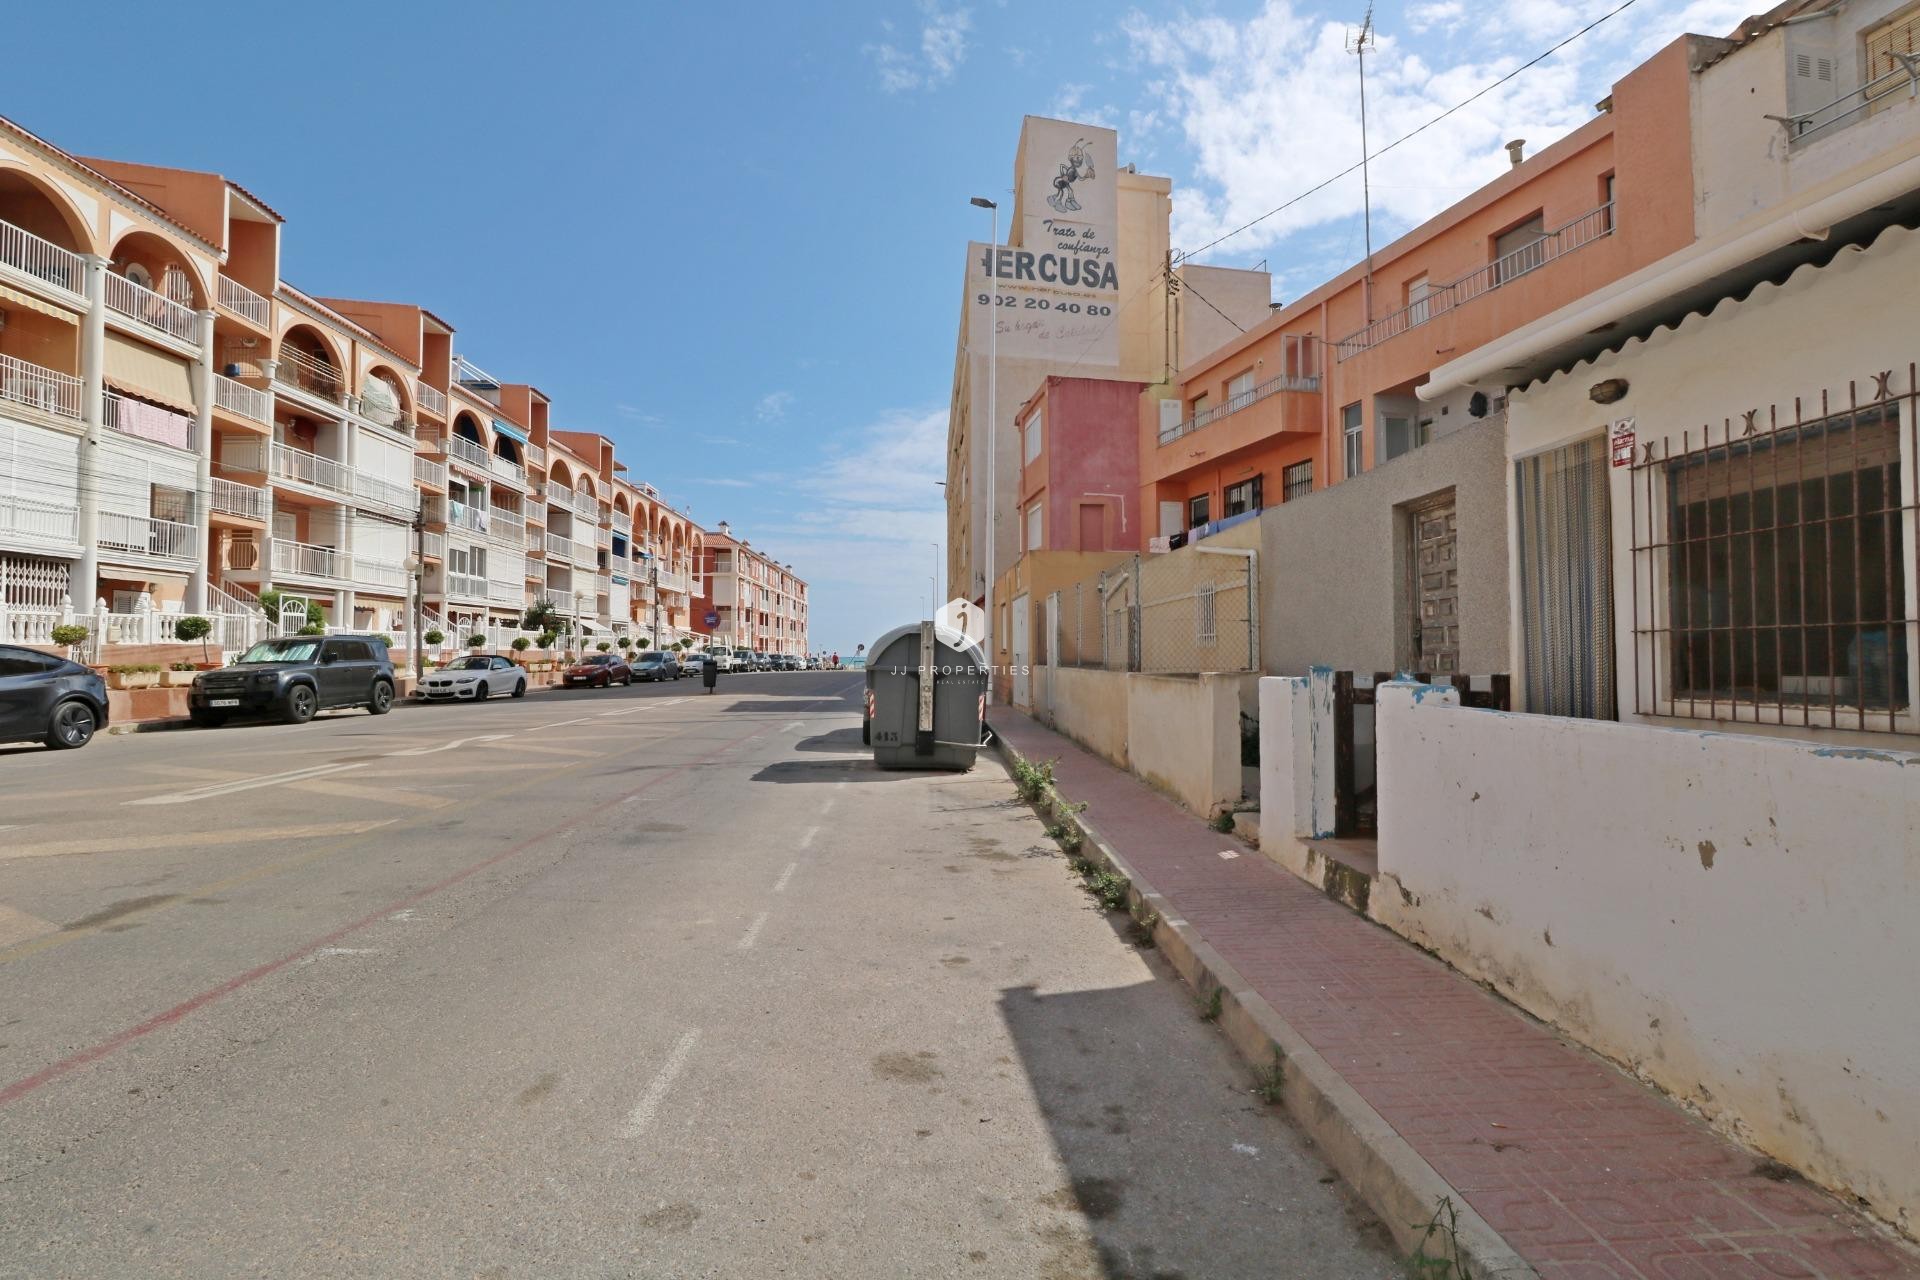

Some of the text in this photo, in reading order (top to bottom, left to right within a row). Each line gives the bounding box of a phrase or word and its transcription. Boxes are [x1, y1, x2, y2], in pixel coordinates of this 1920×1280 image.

[1042, 219, 1096, 240] Trato de
[1057, 239, 1111, 260] confianza
[977, 293, 1111, 317] 902 20 40 80
